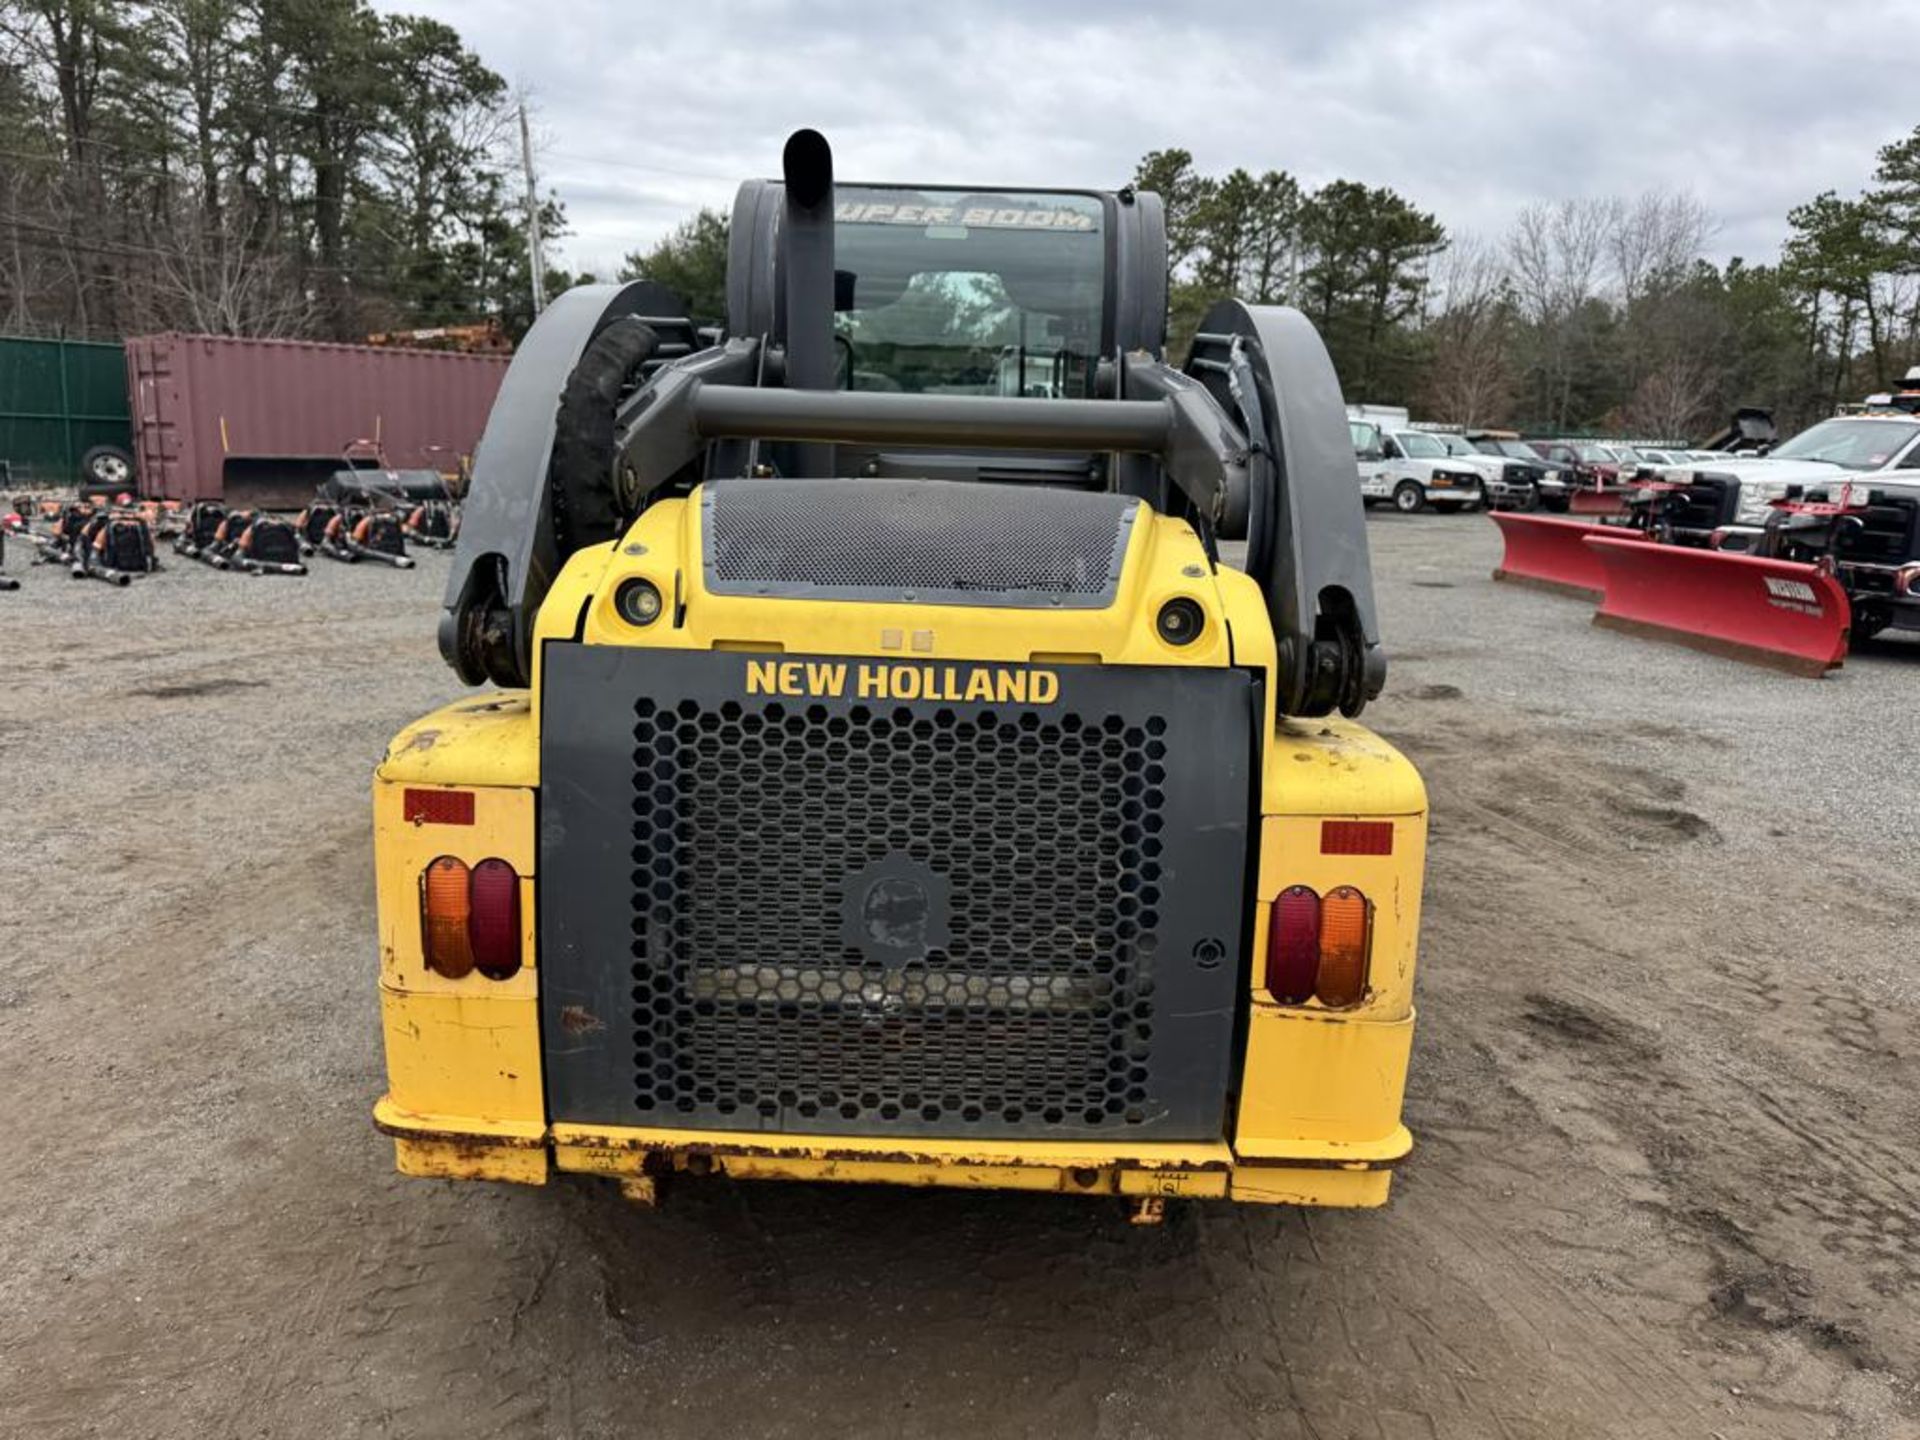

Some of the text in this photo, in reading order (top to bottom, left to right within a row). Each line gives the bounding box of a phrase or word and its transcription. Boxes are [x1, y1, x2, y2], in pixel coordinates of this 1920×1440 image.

[834, 203, 953, 224] UPER
[746, 661, 1059, 704] NEW HOLLAND
